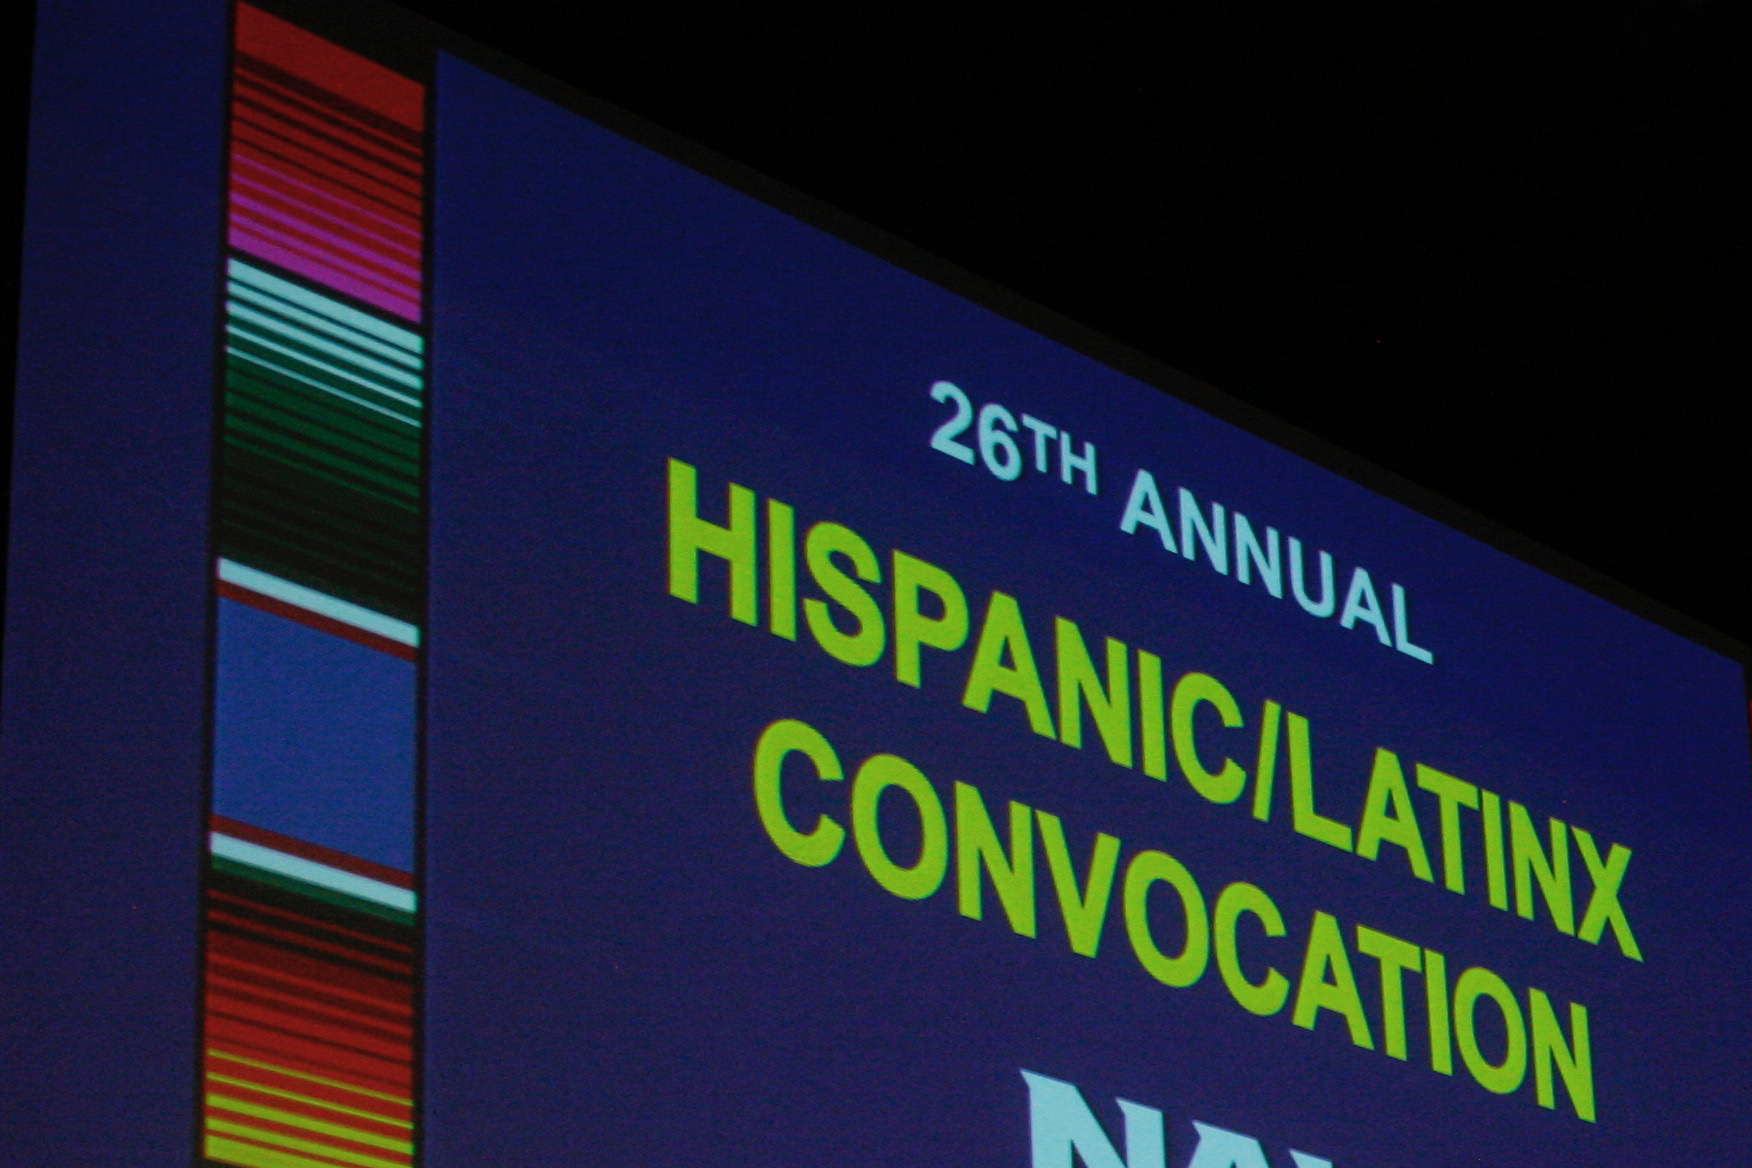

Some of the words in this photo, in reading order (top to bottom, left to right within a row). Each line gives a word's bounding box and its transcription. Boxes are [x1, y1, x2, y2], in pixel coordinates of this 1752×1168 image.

[667, 457, 1644, 963] HISPANIC/LATINX
[929, 380, 1098, 496] 26TH
[1119, 468, 1435, 666] ANNUAL
[753, 718, 1597, 1124] CONVOCATION
